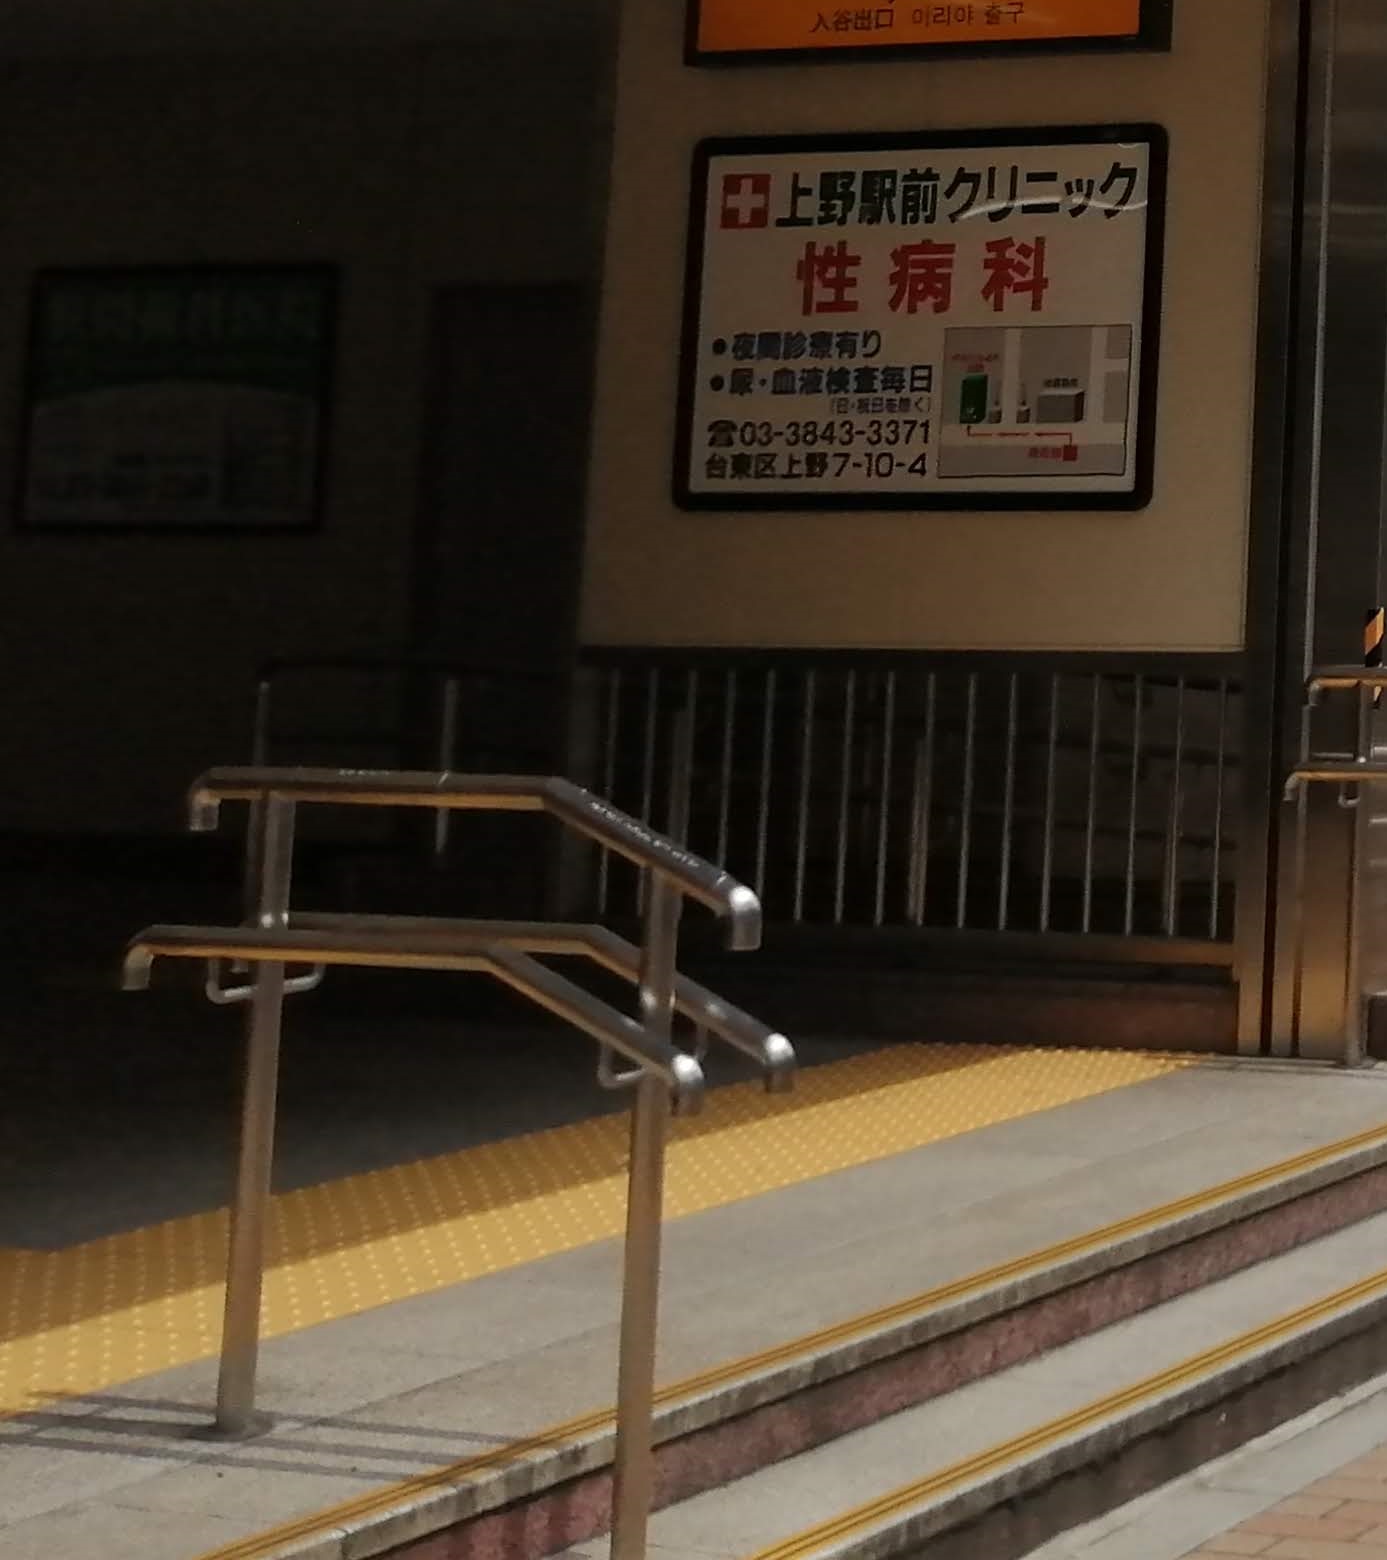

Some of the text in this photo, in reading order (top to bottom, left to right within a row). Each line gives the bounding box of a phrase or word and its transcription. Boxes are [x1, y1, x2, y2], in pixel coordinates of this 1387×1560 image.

[911, 4, 975, 28] 이리야
[774, 161, 1139, 229] 上野駅前クリニック
[796, 236, 1049, 316] 性病科
